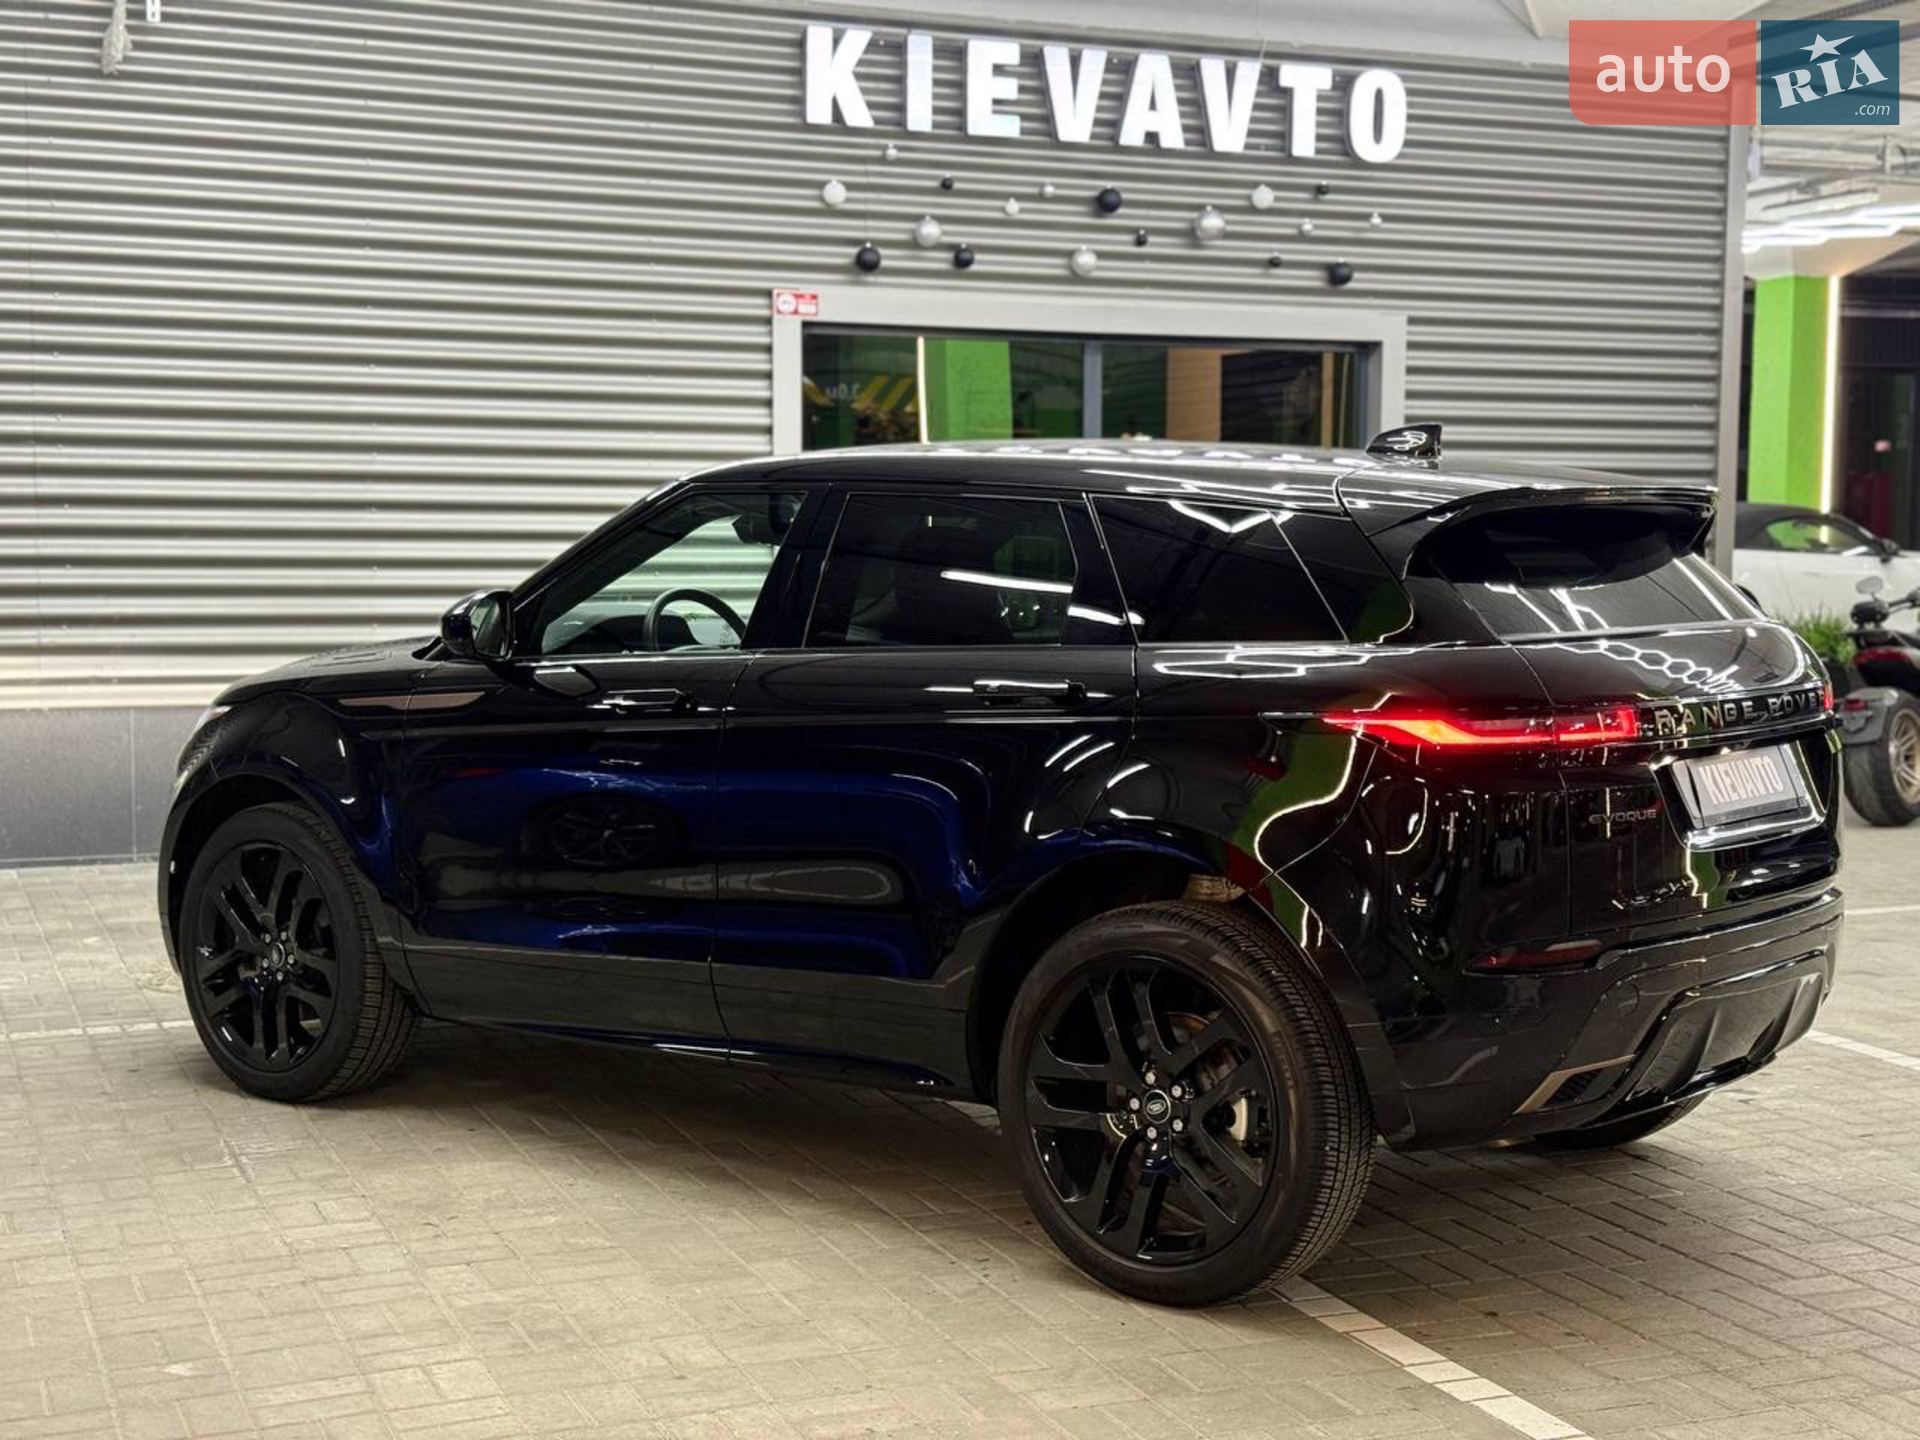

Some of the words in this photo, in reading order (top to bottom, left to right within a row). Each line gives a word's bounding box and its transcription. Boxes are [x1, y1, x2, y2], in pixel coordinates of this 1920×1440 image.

[804, 23, 1408, 164] KIEVAVTO
[1655, 701, 1755, 731] RANGE
[1698, 756, 1784, 805] KIEVAVTO
[1589, 808, 1657, 824] EVOQUE
